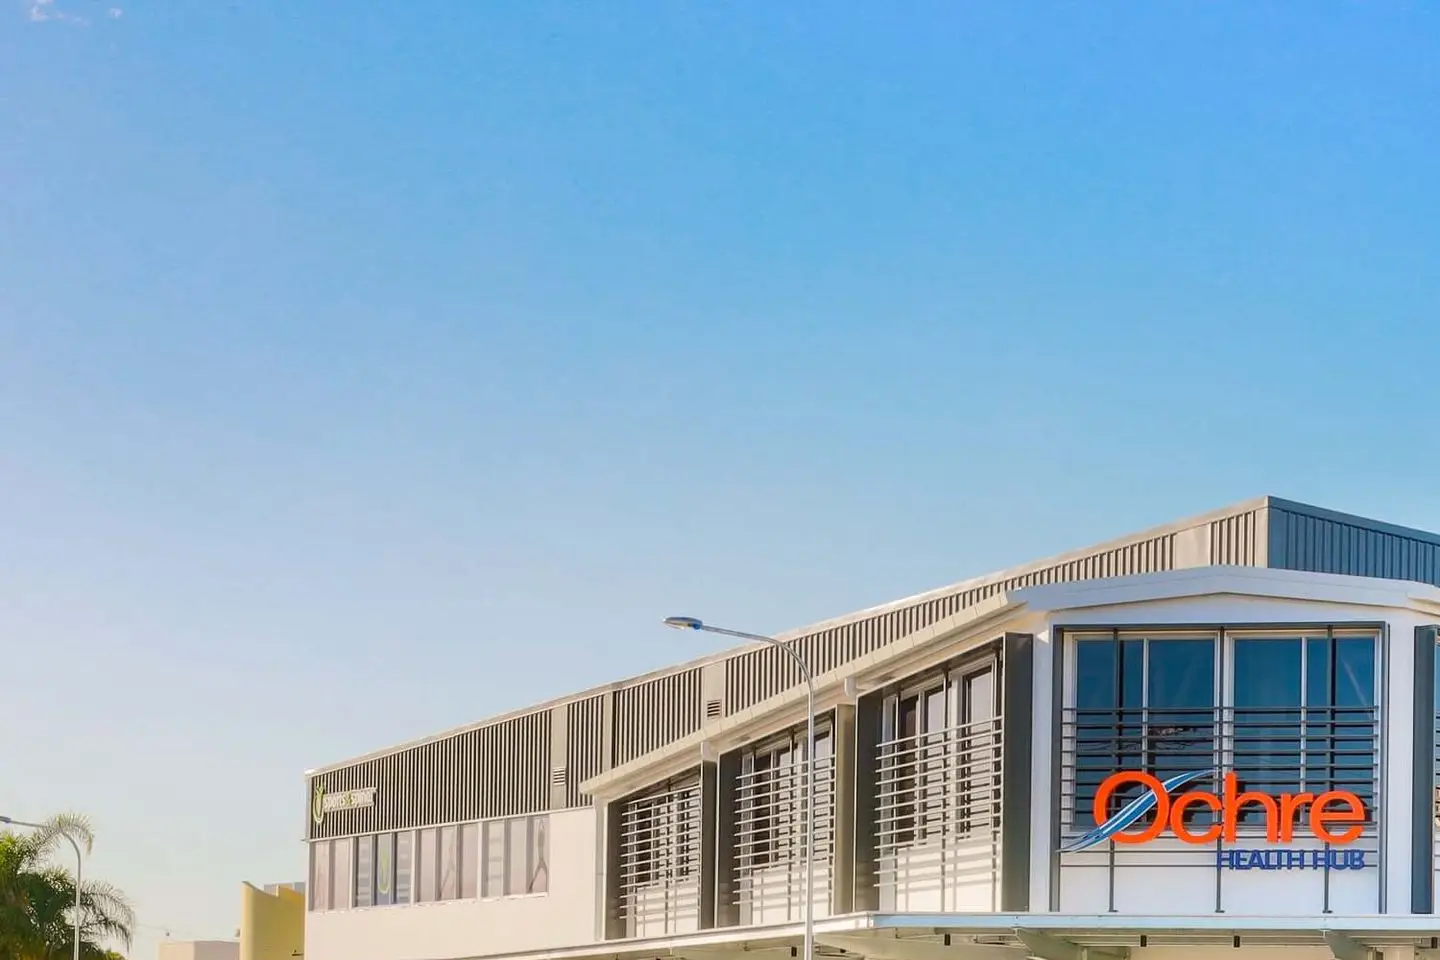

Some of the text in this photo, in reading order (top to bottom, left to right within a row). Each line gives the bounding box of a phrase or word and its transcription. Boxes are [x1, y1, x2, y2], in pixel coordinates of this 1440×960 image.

[1093, 770, 1366, 844] Ochre
[1217, 849, 1365, 870] HEALTH HUB
